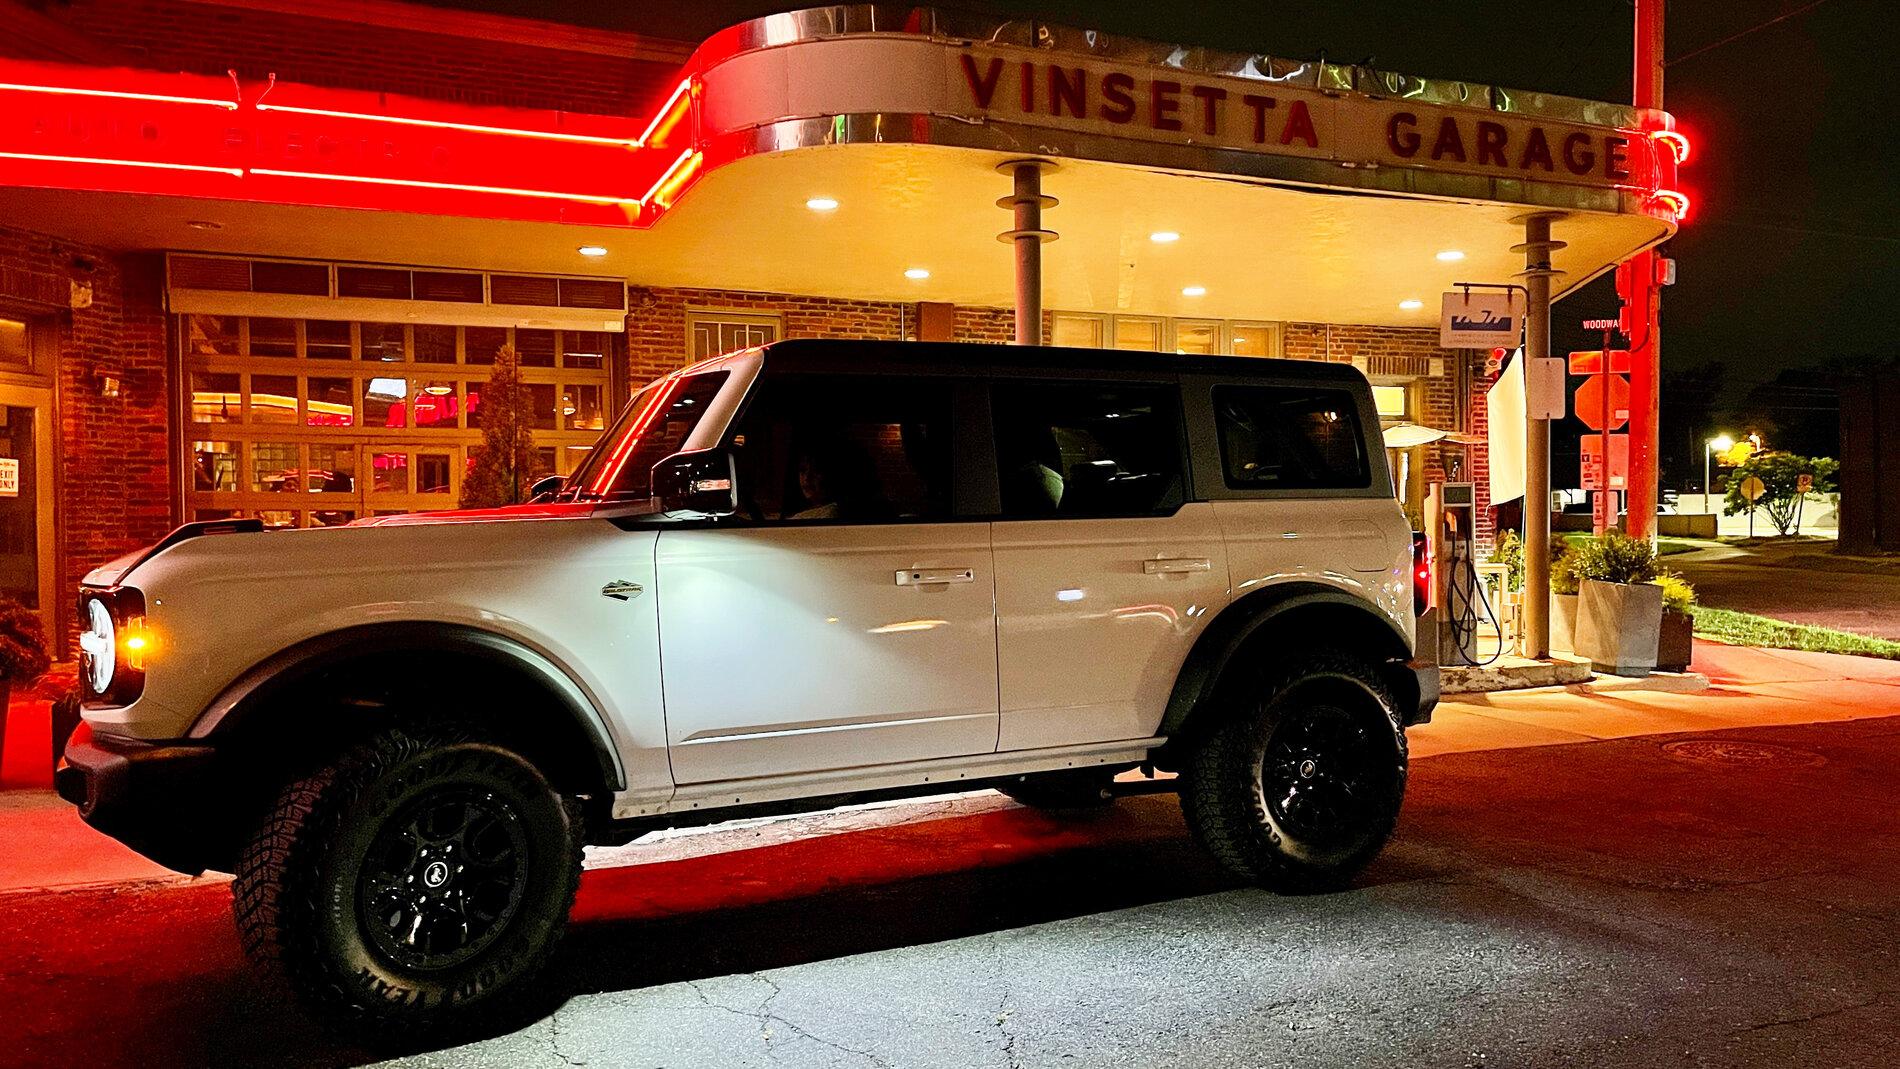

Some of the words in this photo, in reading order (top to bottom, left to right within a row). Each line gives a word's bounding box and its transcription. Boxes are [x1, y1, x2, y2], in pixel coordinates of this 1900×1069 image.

[960, 53, 1319, 148] VINSETTA
[1387, 111, 1631, 180] GARAGE
[1583, 319, 1621, 329] WOODWA
